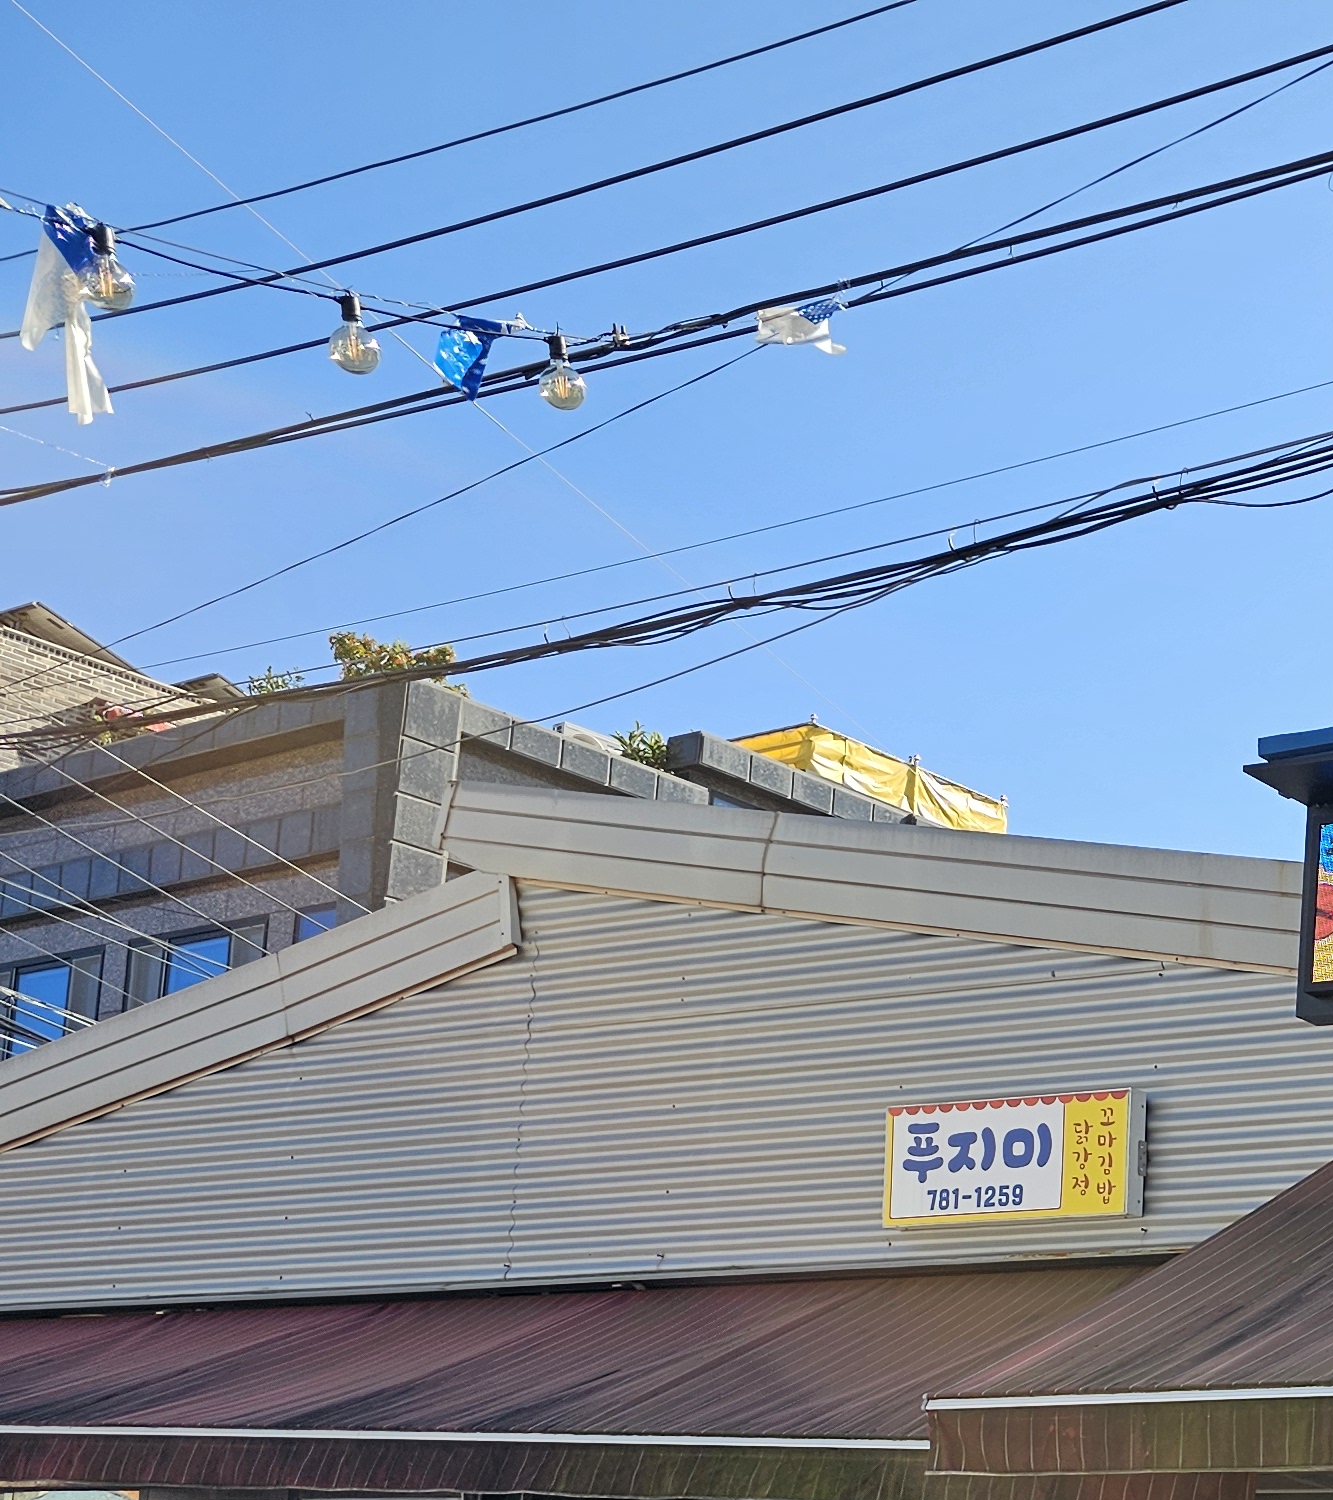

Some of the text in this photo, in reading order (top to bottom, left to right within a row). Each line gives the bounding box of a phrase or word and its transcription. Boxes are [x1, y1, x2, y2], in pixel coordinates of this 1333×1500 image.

[1071, 1119, 1093, 1197] 닭강정
[1096, 1107, 1117, 1205] 꼬마김밥
[927, 1184, 1024, 1210] 781-1259
